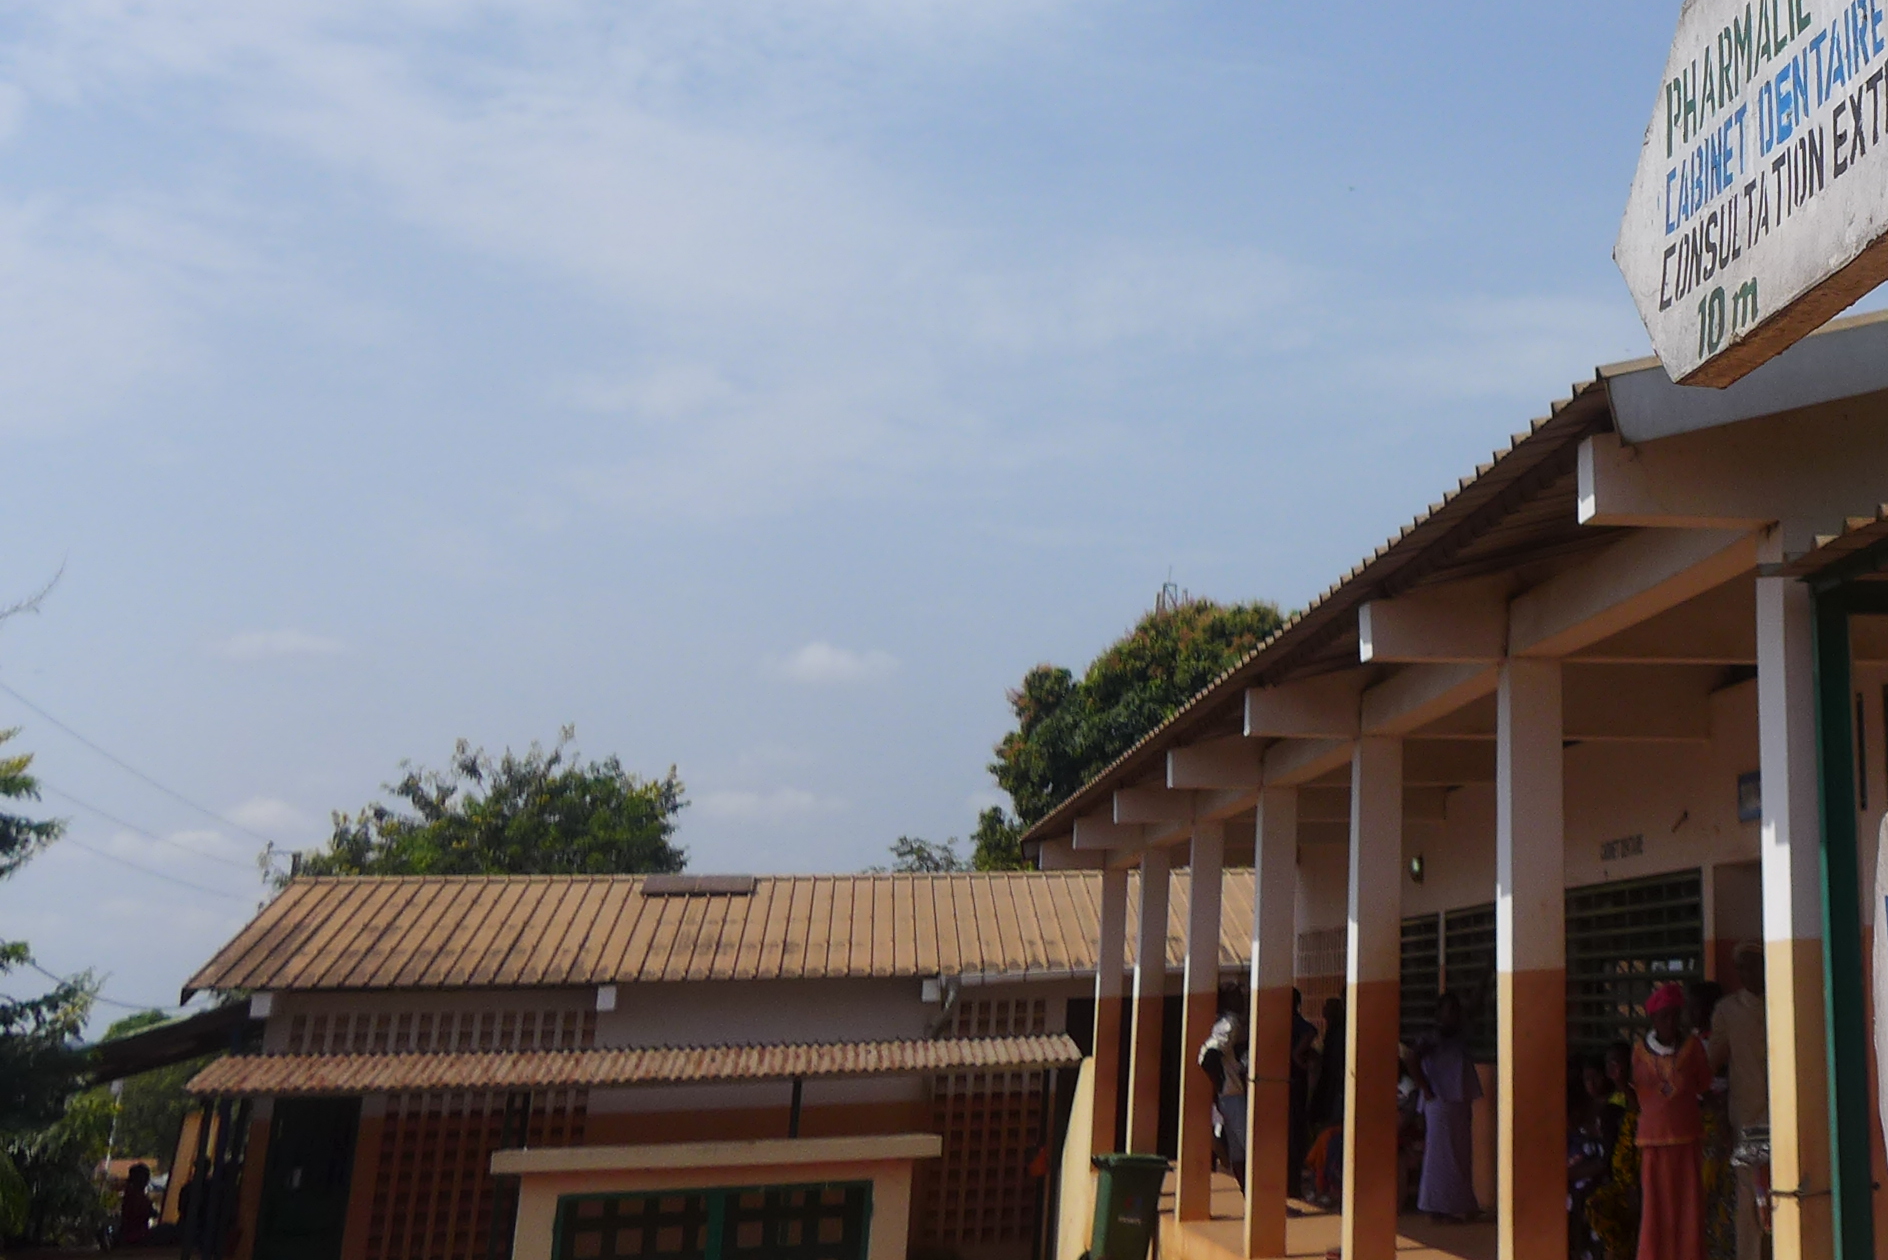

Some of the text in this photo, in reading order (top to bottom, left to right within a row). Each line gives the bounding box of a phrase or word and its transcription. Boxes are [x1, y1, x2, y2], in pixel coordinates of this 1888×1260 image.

[1658, 124, 1826, 313] CONSULTATION
[1664, 101, 1748, 237] CABINET
[1697, 276, 1759, 360] 10 m
